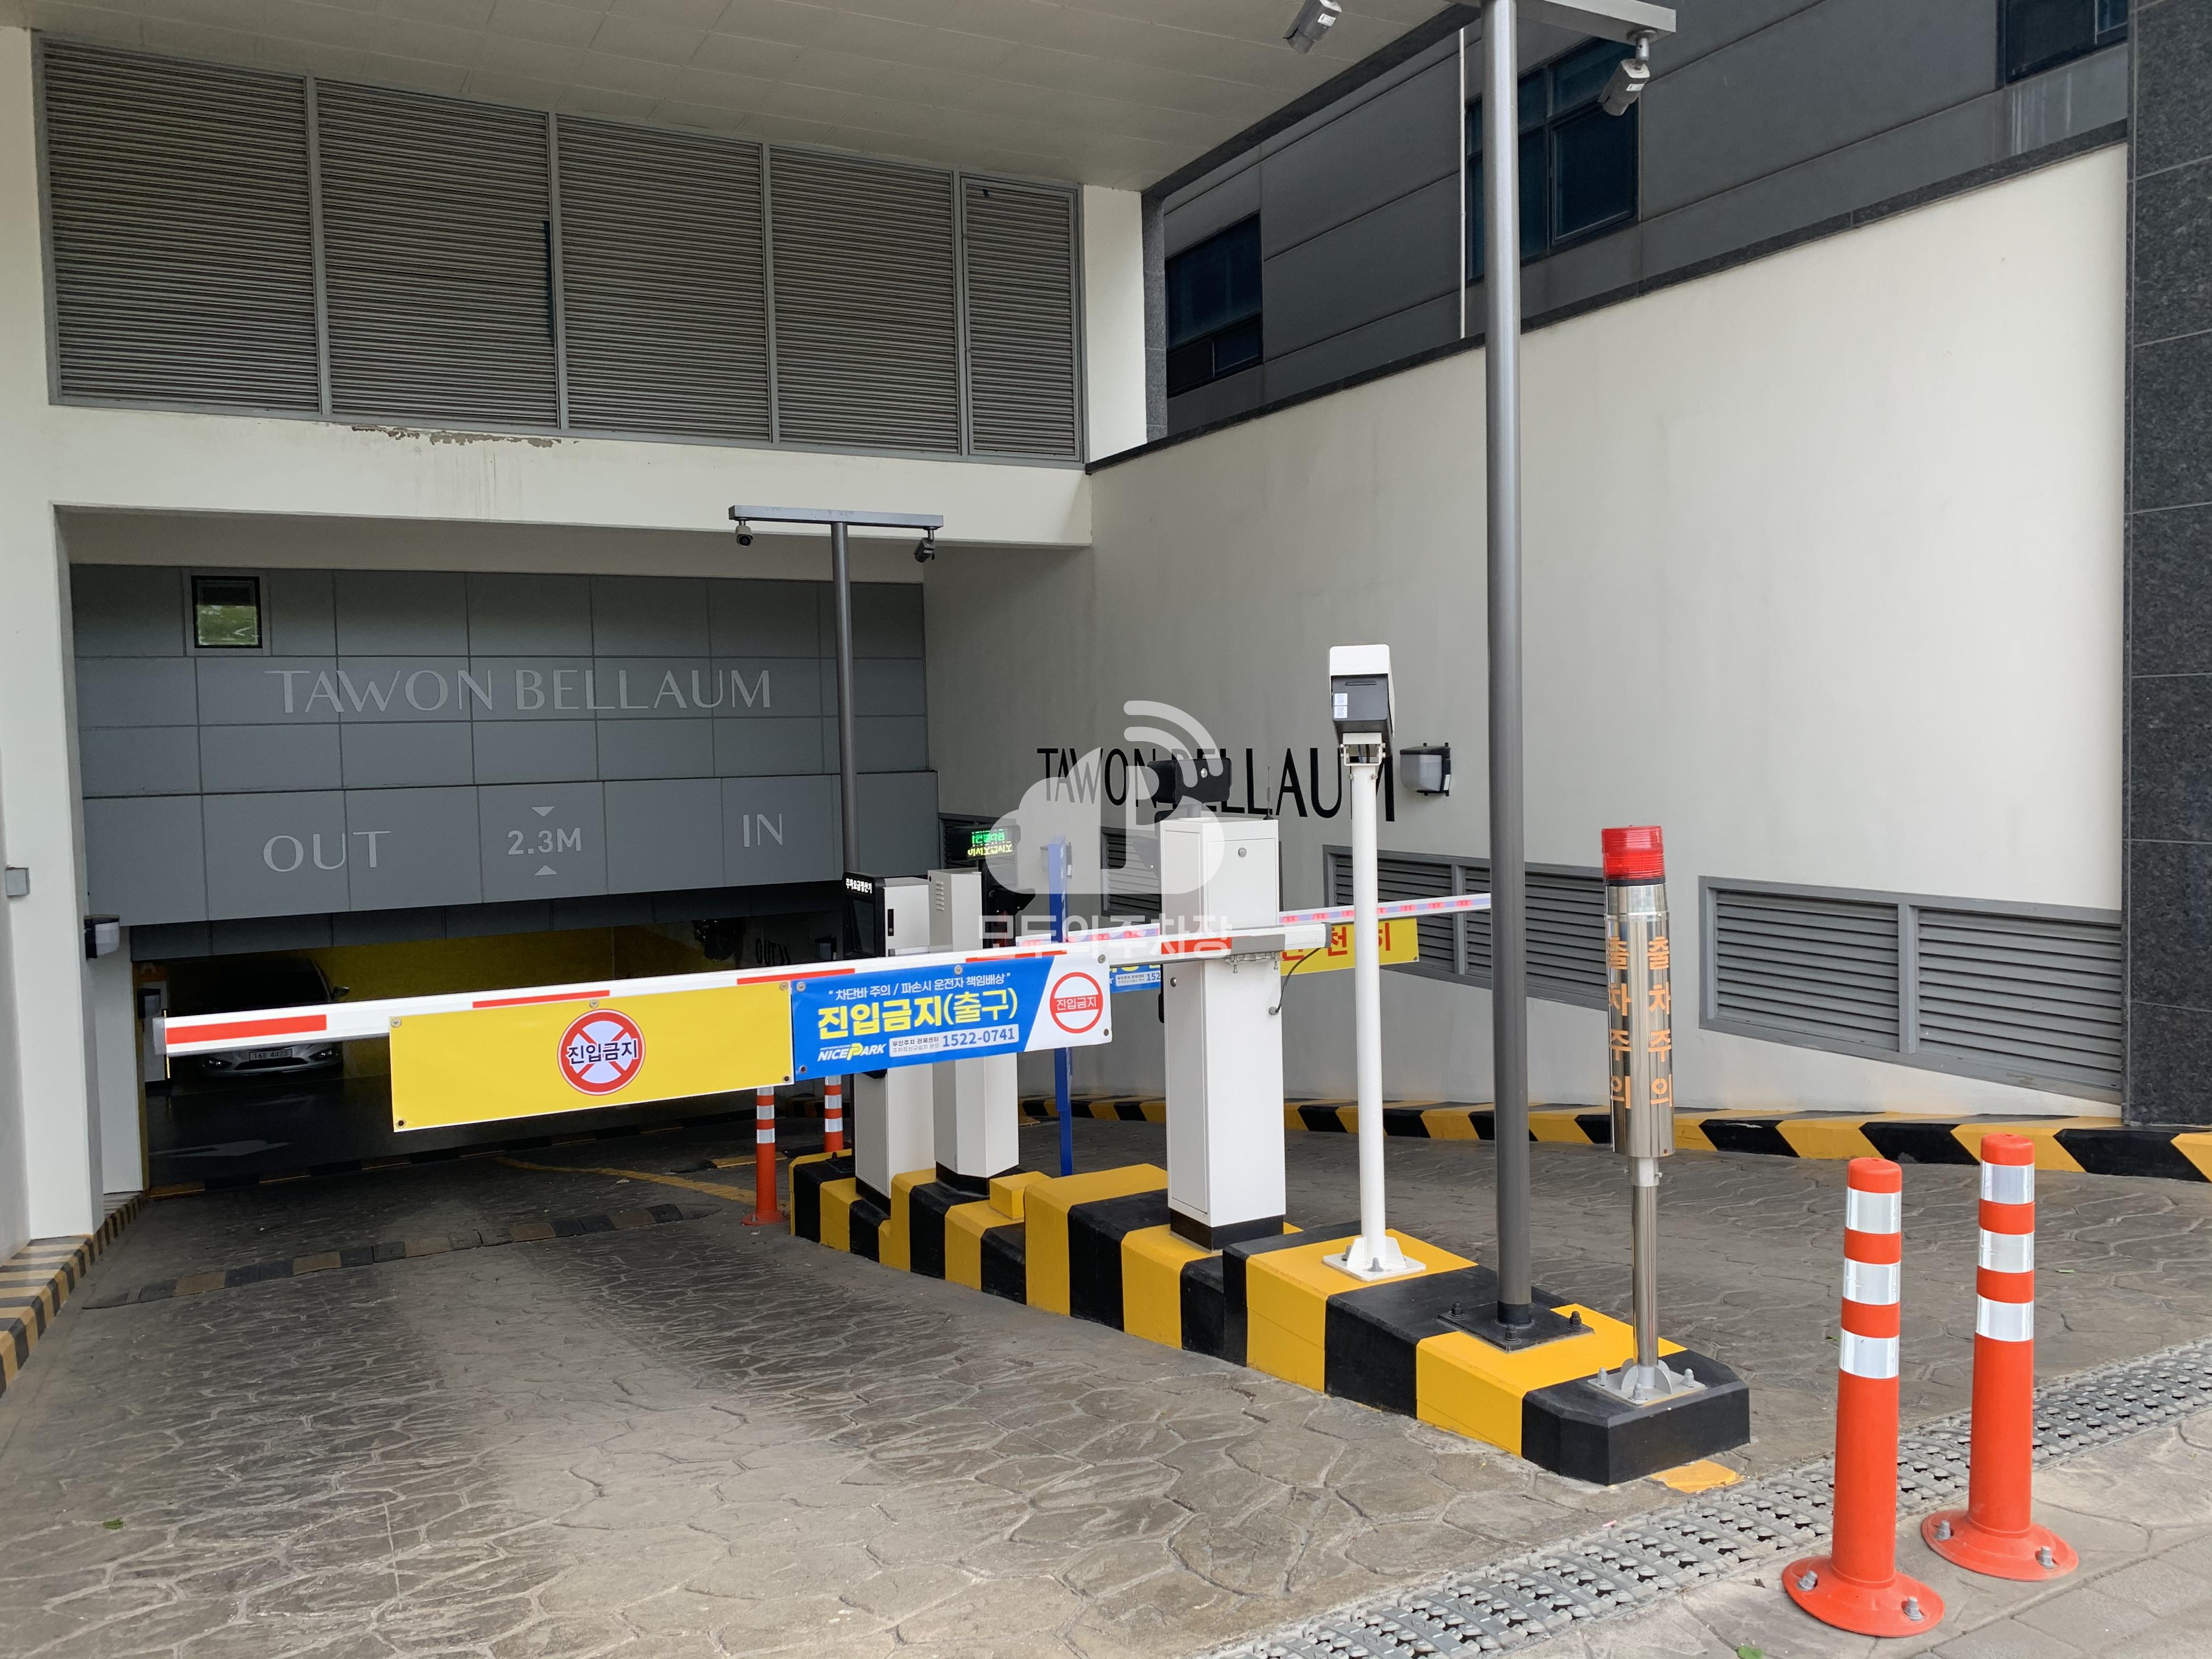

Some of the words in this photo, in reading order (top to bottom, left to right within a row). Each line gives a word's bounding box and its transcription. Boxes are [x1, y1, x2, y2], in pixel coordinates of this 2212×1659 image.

[265, 669, 493, 714] TAWON
[515, 668, 771, 711] BELLAUM
[506, 827, 582, 856] 2.3M
[742, 814, 783, 848] IN
[263, 830, 391, 872] OUT
[870, 986, 891, 998] 주의
[901, 980, 932, 994] 파손시
[934, 977, 964, 990] 운전자
[818, 988, 1018, 1040] 진입금지(출구)
[1057, 996, 1097, 1011] 진입금지
[943, 1028, 1015, 1048] 1522-0741
[567, 1039, 639, 1065] 진입금지
[817, 1043, 887, 1062] NICEPARK
